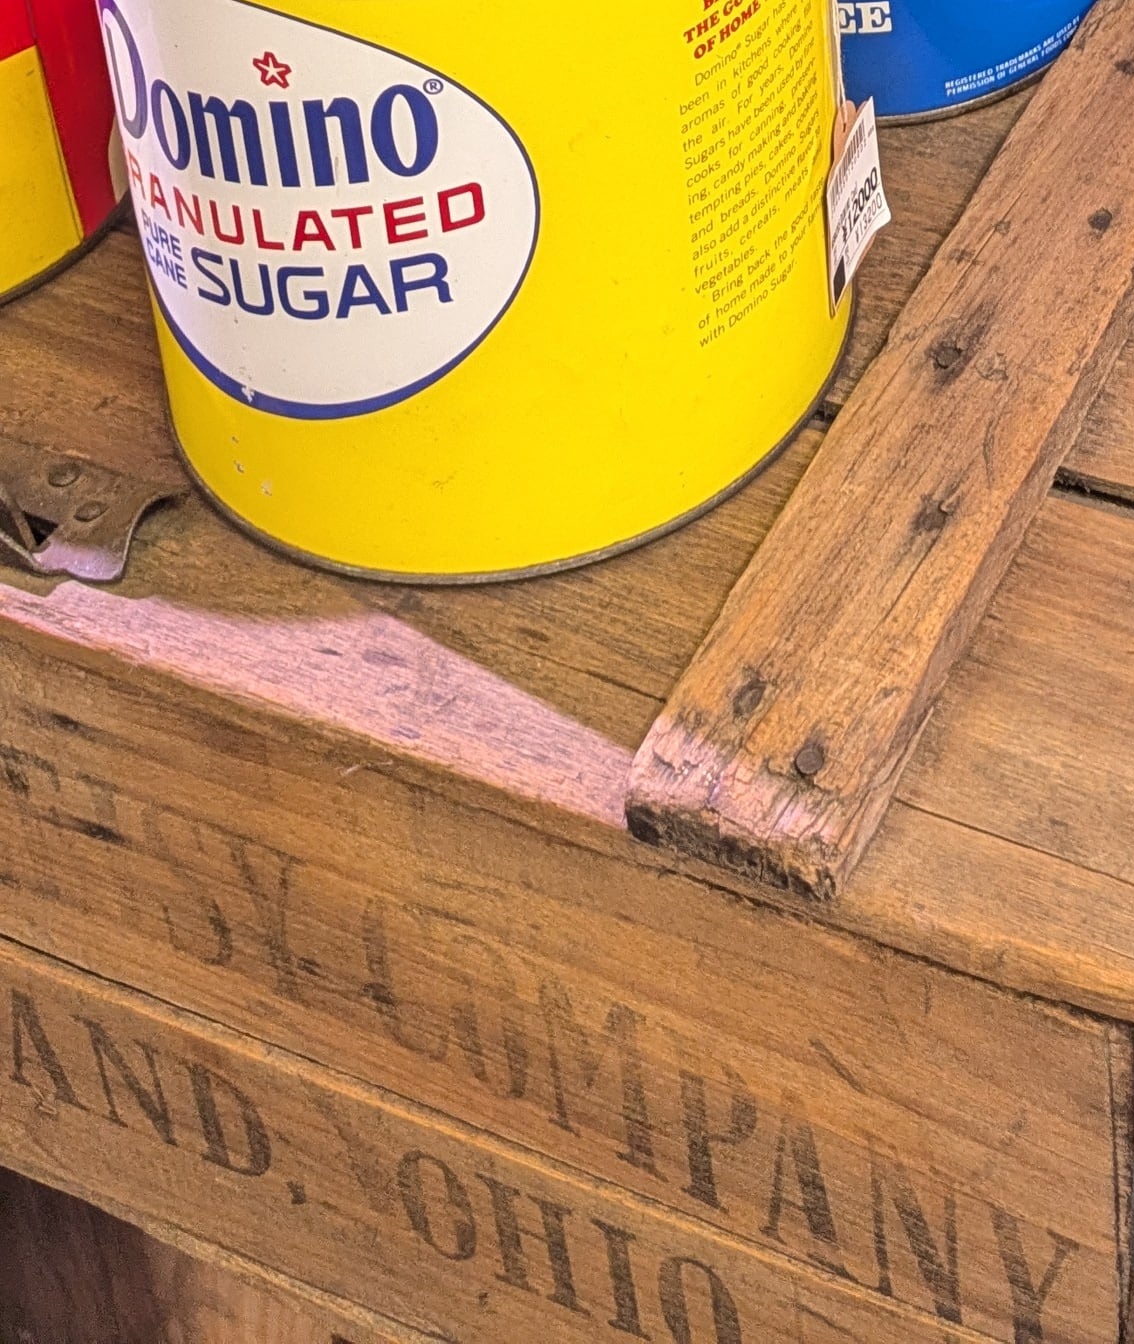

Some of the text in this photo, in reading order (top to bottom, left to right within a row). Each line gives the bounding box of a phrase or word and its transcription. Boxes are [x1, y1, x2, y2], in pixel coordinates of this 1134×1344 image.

[683, 10, 720, 44] THE
[693, 35, 717, 60] OF
[744, 15, 770, 48] Sugar
[679, 91, 710, 116] been
[716, 78, 727, 92] in
[732, 36, 772, 79] kitchens
[680, 99, 726, 134] aromas
[731, 82, 741, 100] of
[747, 56, 769, 89] good
[773, 18, 801, 59] cooking
[682, 133, 703, 153] the
[736, 94, 754, 114] For
[684, 137, 726, 170] Sugars
[727, 114, 752, 141] have
[753, 91, 776, 118] been
[713, 158, 746, 190] candy
[747, 123, 781, 163] making
[127, 148, 486, 251] RANULATED
[686, 159, 721, 188] cooks
[728, 141, 743, 160] for
[690, 221, 714, 244] and
[764, 145, 797, 185] Domino
[141, 208, 183, 261] PURE
[688, 180, 742, 225] tempting
[692, 238, 717, 261] also
[719, 221, 740, 244] add
[742, 213, 749, 226] a
[750, 164, 796, 217] distinctive
[191, 246, 454, 320] SUGAR
[698, 316, 711, 330] of
[715, 292, 747, 319] home
[749, 262, 776, 293] made
[778, 250, 788, 264] to
[711, 274, 744, 303] Bring
[747, 249, 771, 276] back
[773, 230, 788, 250] the
[699, 325, 726, 348] with
[728, 289, 769, 328] Domino
[402, 1146, 746, 1344] OHIO
